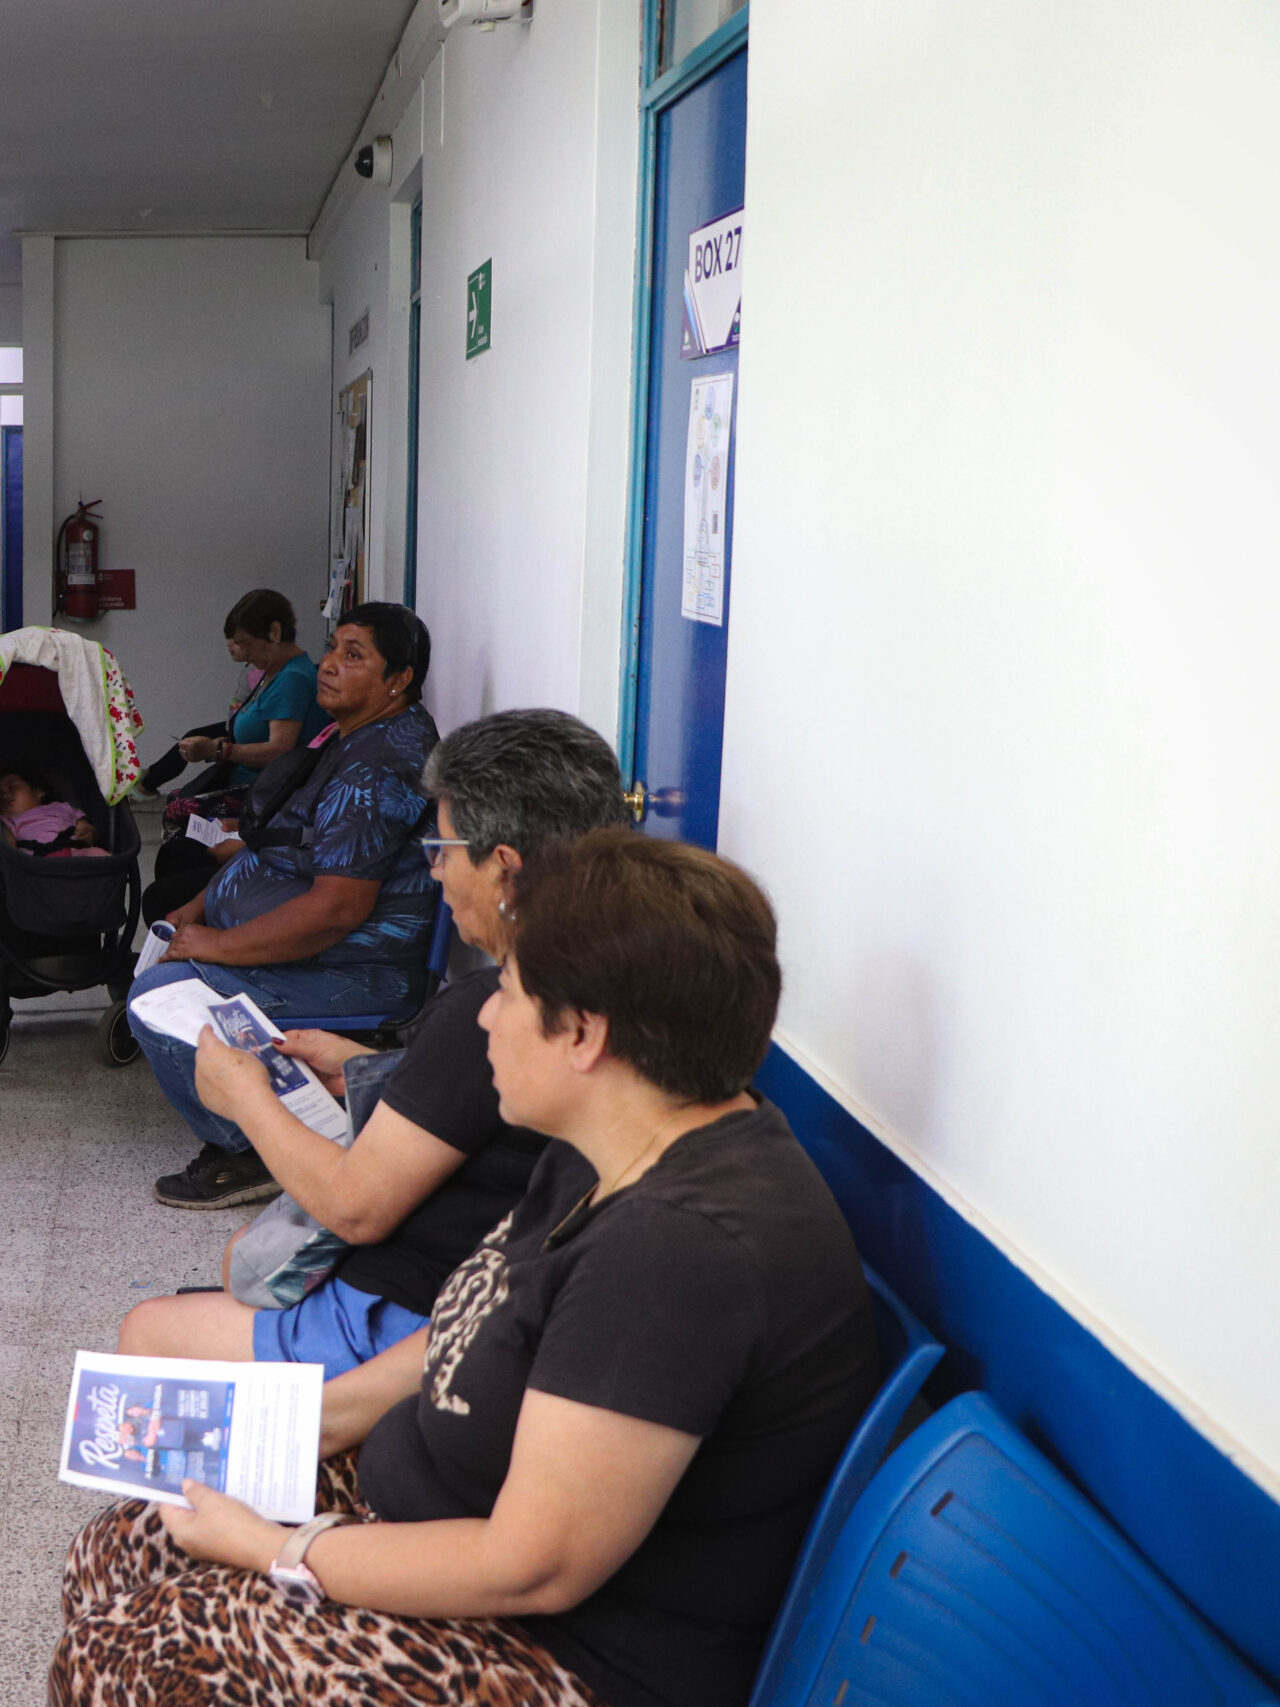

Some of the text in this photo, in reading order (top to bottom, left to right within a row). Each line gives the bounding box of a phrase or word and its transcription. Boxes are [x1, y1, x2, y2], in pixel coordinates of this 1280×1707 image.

[695, 225, 742, 283] BOX 27
[79, 1383, 125, 1470] Respeta
